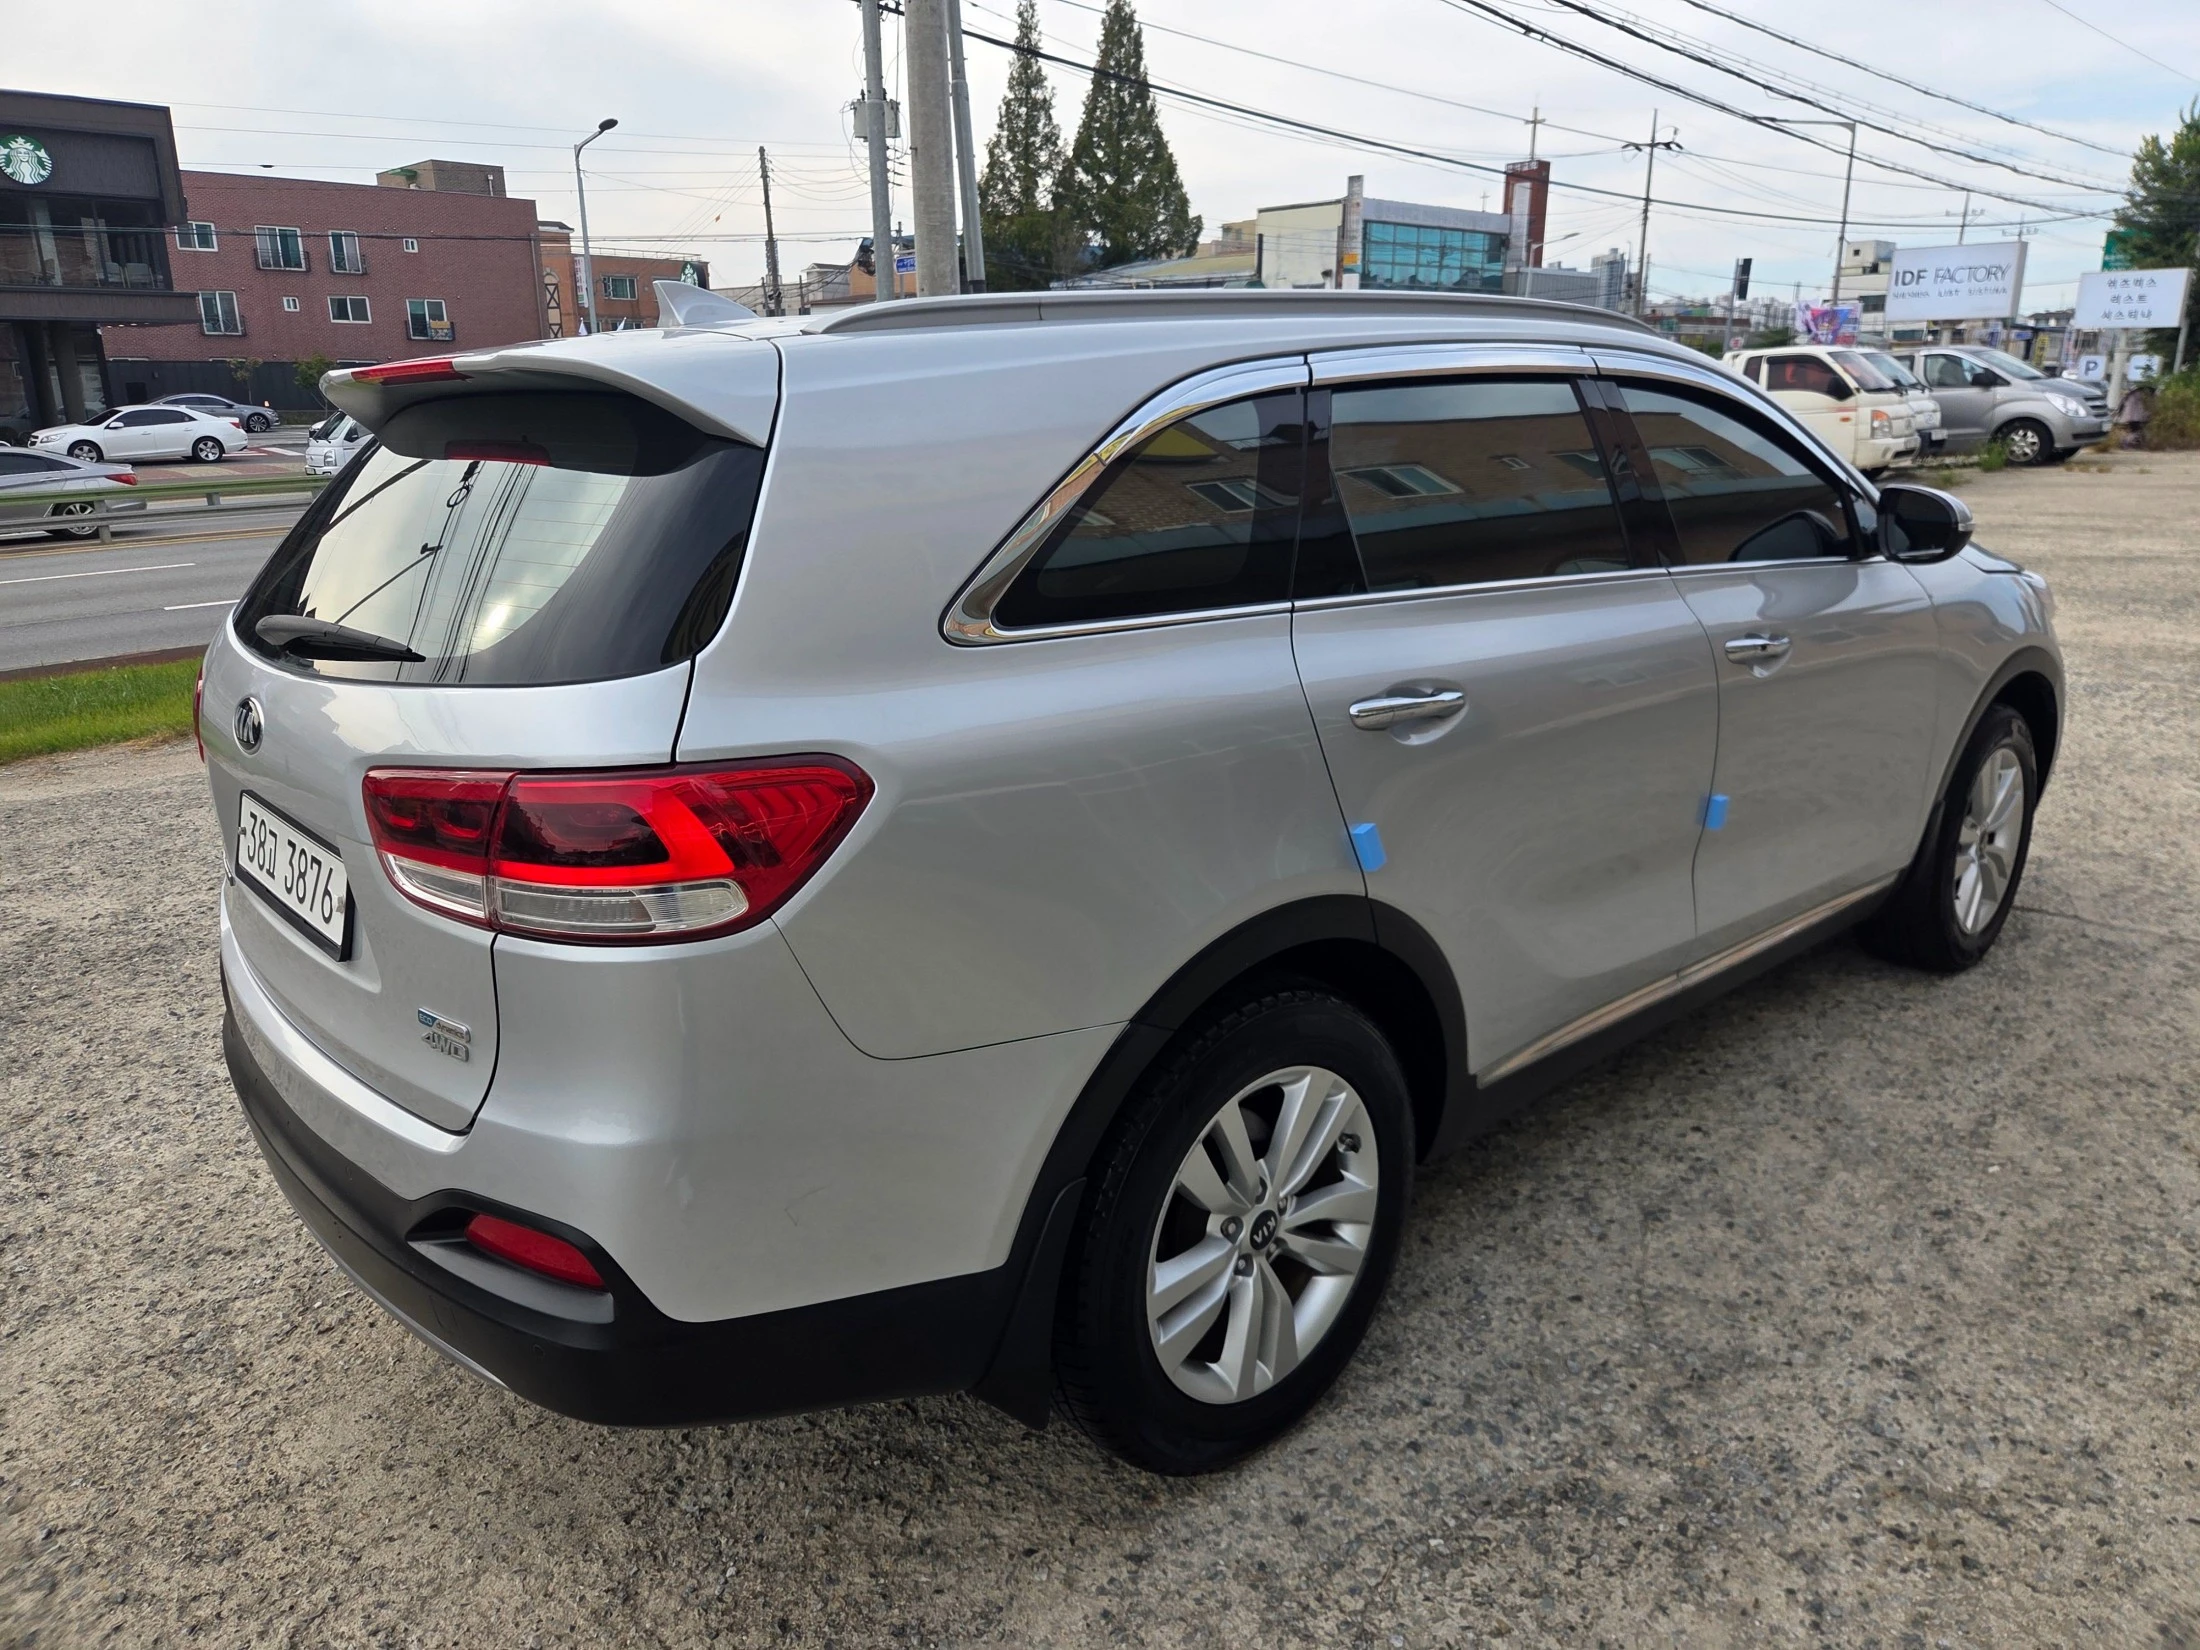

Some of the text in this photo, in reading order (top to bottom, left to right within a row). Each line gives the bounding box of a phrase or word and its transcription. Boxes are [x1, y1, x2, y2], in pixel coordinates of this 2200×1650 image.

[1895, 263, 2011, 287] IDF FACTORY
[2084, 360, 2098, 376] P
[285, 838, 333, 924] 3876
[421, 1030, 469, 1063] 4WD
[1253, 1216, 1276, 1243] KIA
